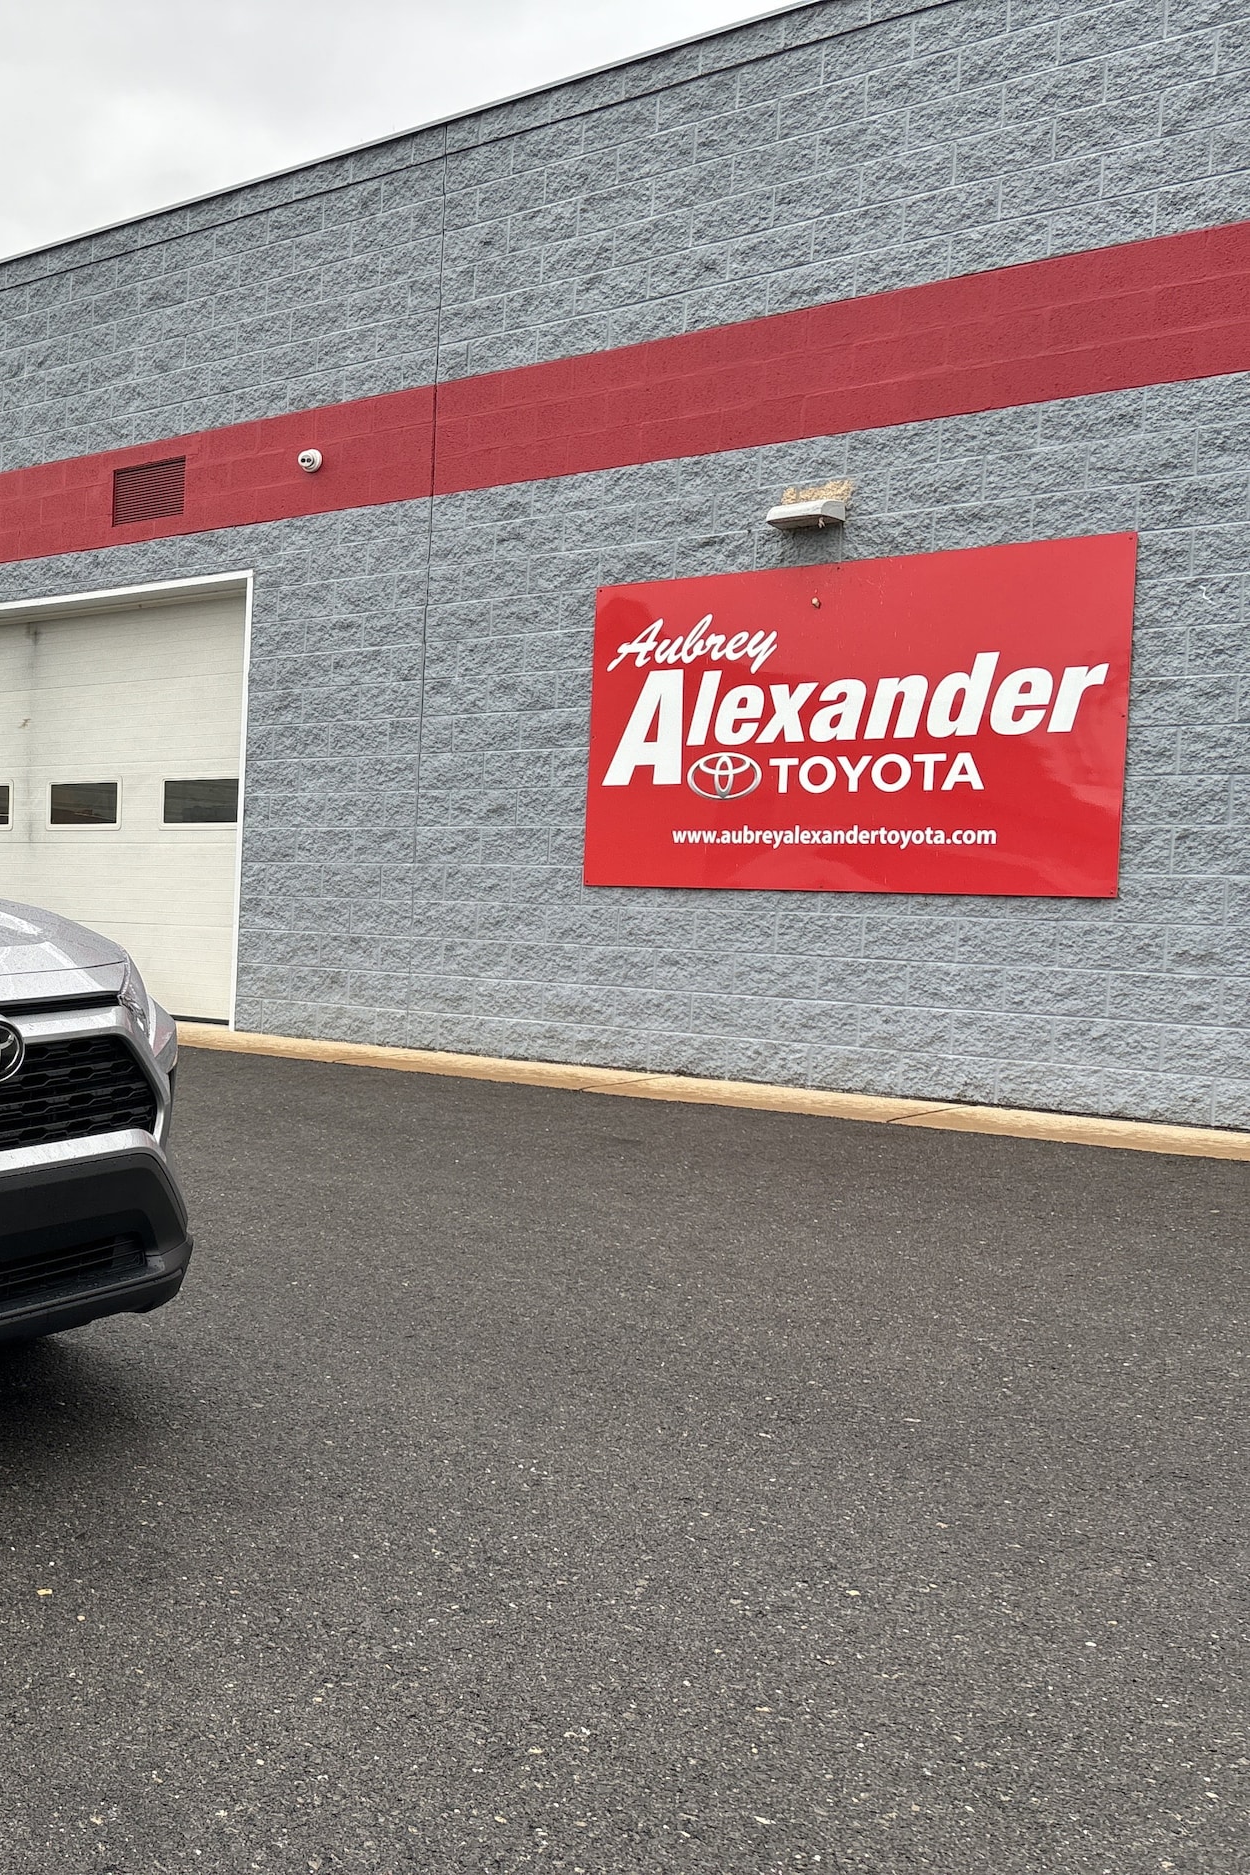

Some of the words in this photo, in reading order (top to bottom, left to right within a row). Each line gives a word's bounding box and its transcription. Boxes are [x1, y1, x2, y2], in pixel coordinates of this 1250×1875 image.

[606, 613, 778, 674] Aubrey
[601, 651, 1110, 787] Alexander
[769, 752, 985, 794] TOYOTA
[672, 824, 997, 850] www.aubreyalexandertoyota.com
